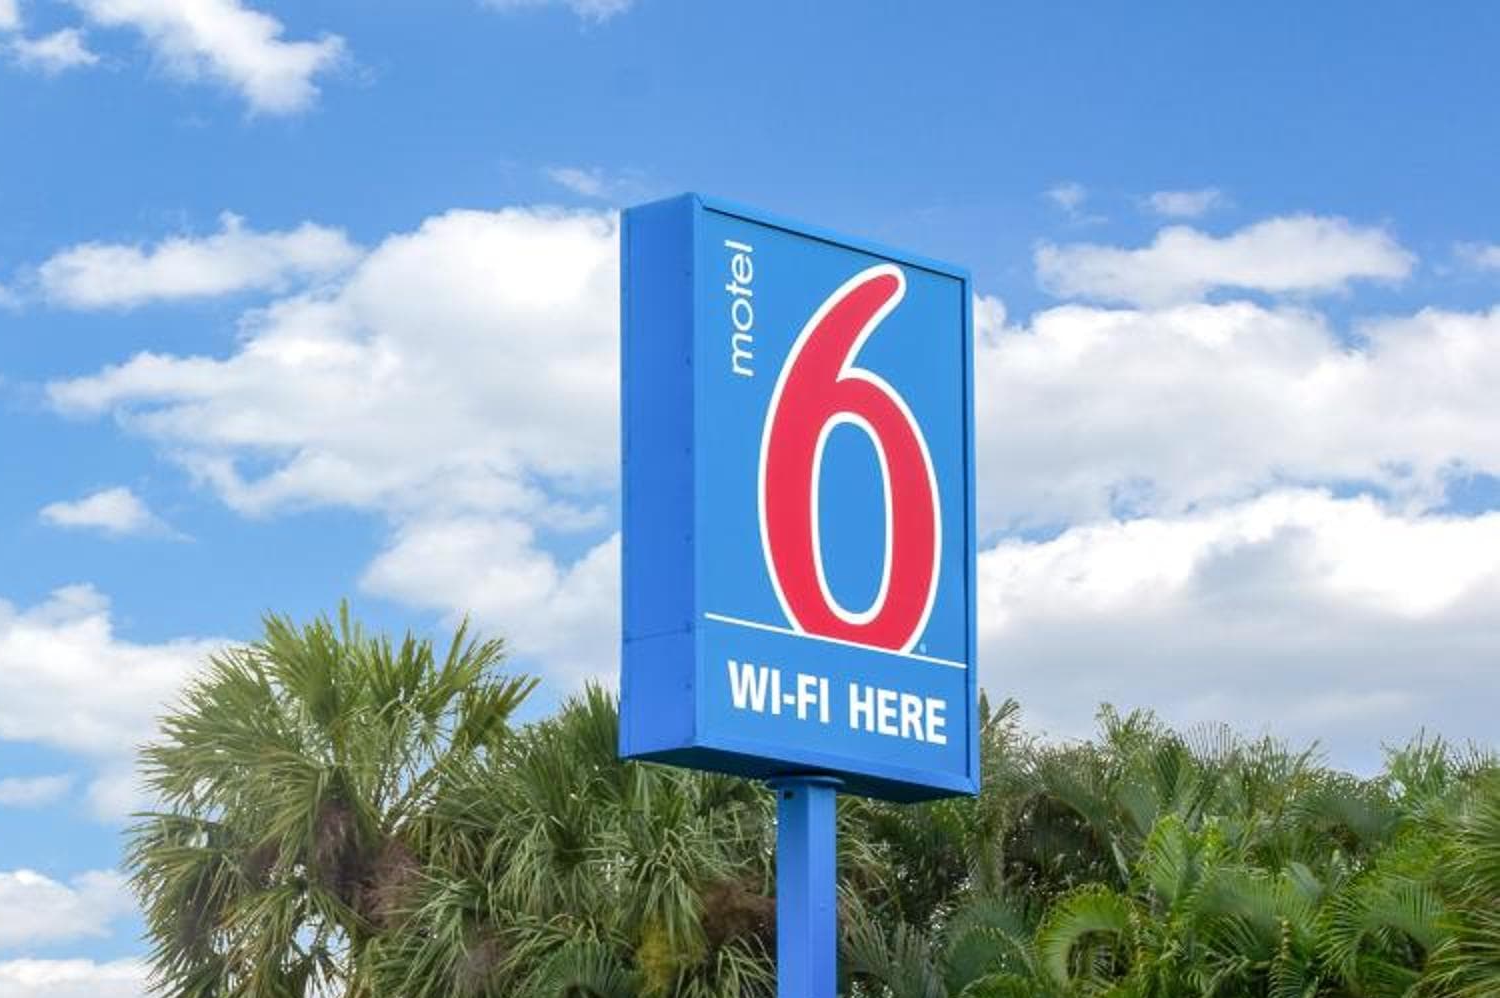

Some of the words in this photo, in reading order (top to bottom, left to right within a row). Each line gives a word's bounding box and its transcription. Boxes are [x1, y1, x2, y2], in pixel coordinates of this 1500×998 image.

[725, 240, 754, 377] motel
[756, 262, 943, 656] 6
[727, 660, 830, 723] WI-FI
[849, 682, 947, 745] HERE
